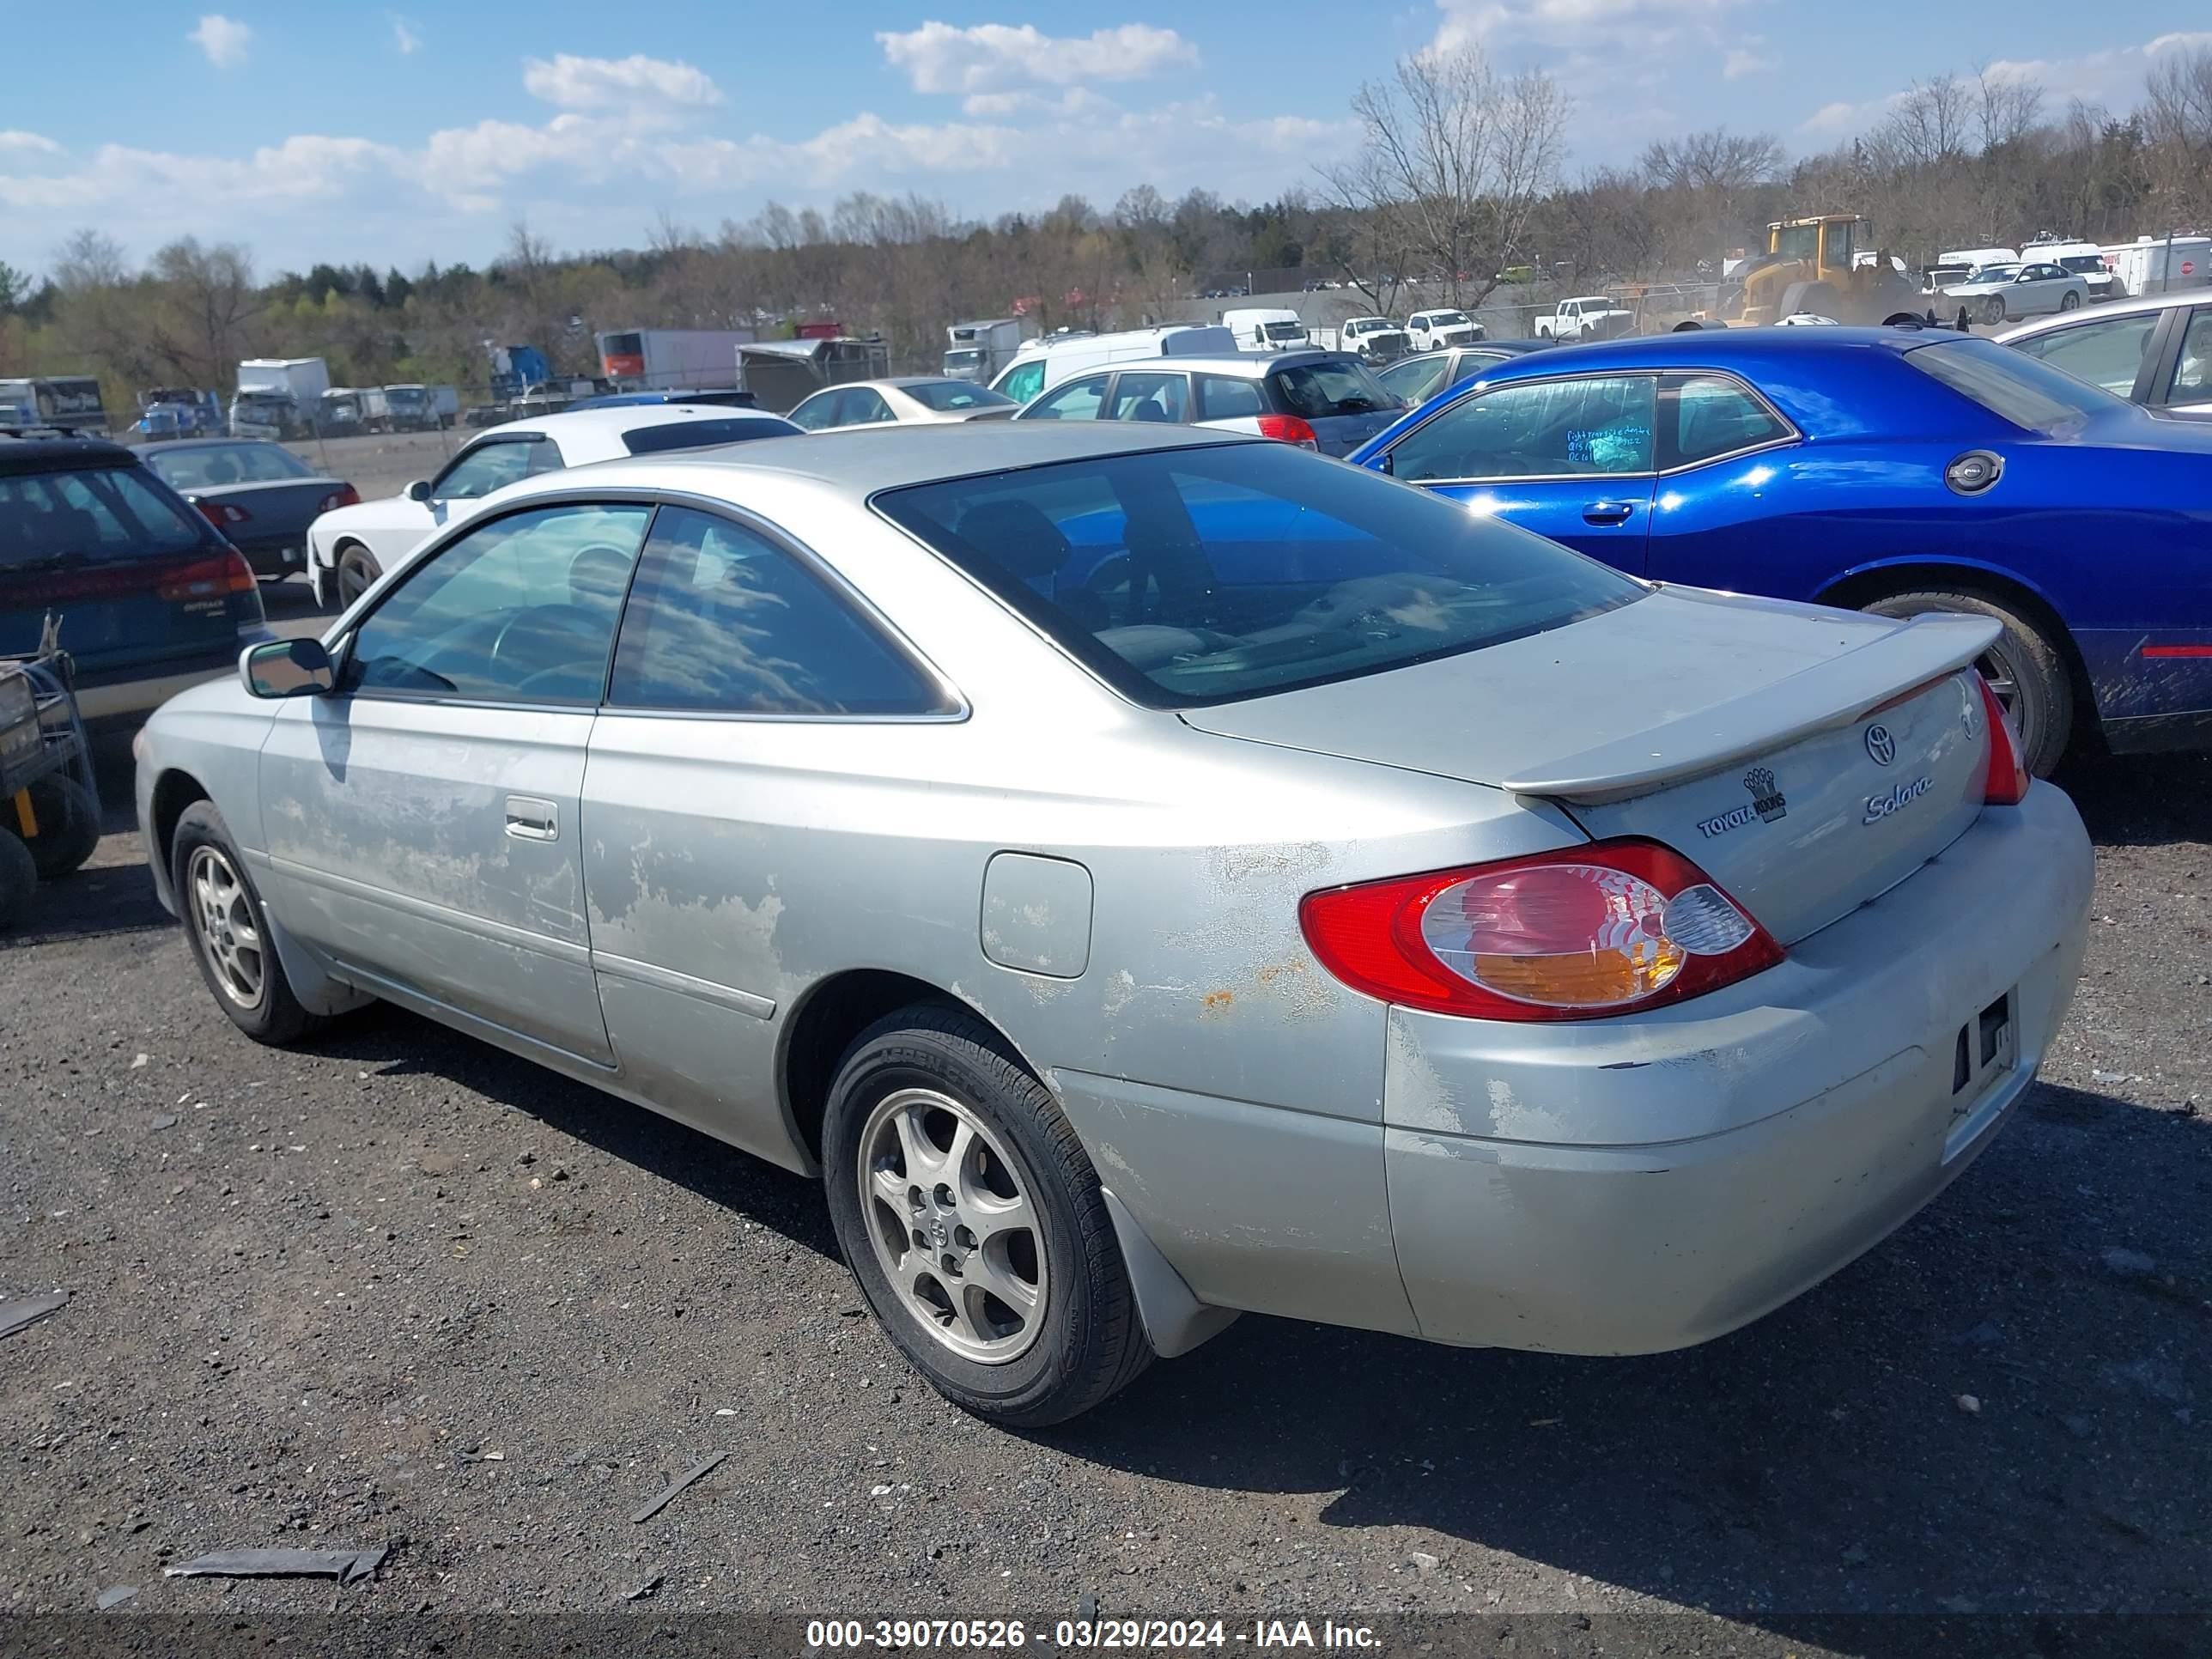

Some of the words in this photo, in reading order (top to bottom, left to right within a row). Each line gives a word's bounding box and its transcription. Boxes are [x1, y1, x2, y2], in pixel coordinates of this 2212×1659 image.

[1753, 792, 1787, 816] KOONS
[1863, 775, 1934, 826] Solara
[1698, 805, 1758, 838] TOYOTA
